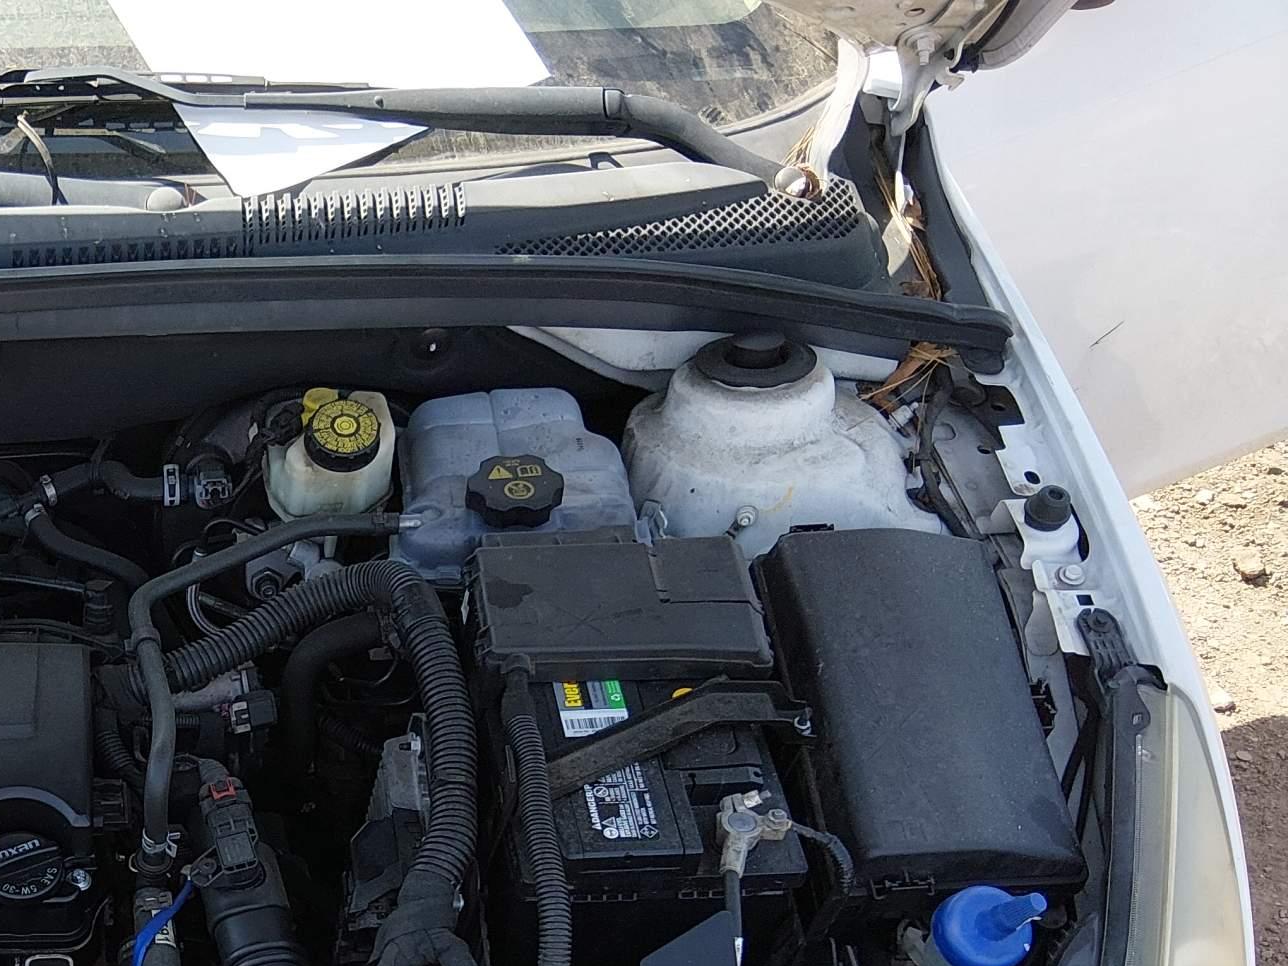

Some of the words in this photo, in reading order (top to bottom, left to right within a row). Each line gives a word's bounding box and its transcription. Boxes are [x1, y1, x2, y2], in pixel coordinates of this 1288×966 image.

[563, 681, 582, 707] Ever
[40, 867, 58, 886] SAE
[1, 883, 38, 895] 5W-30
